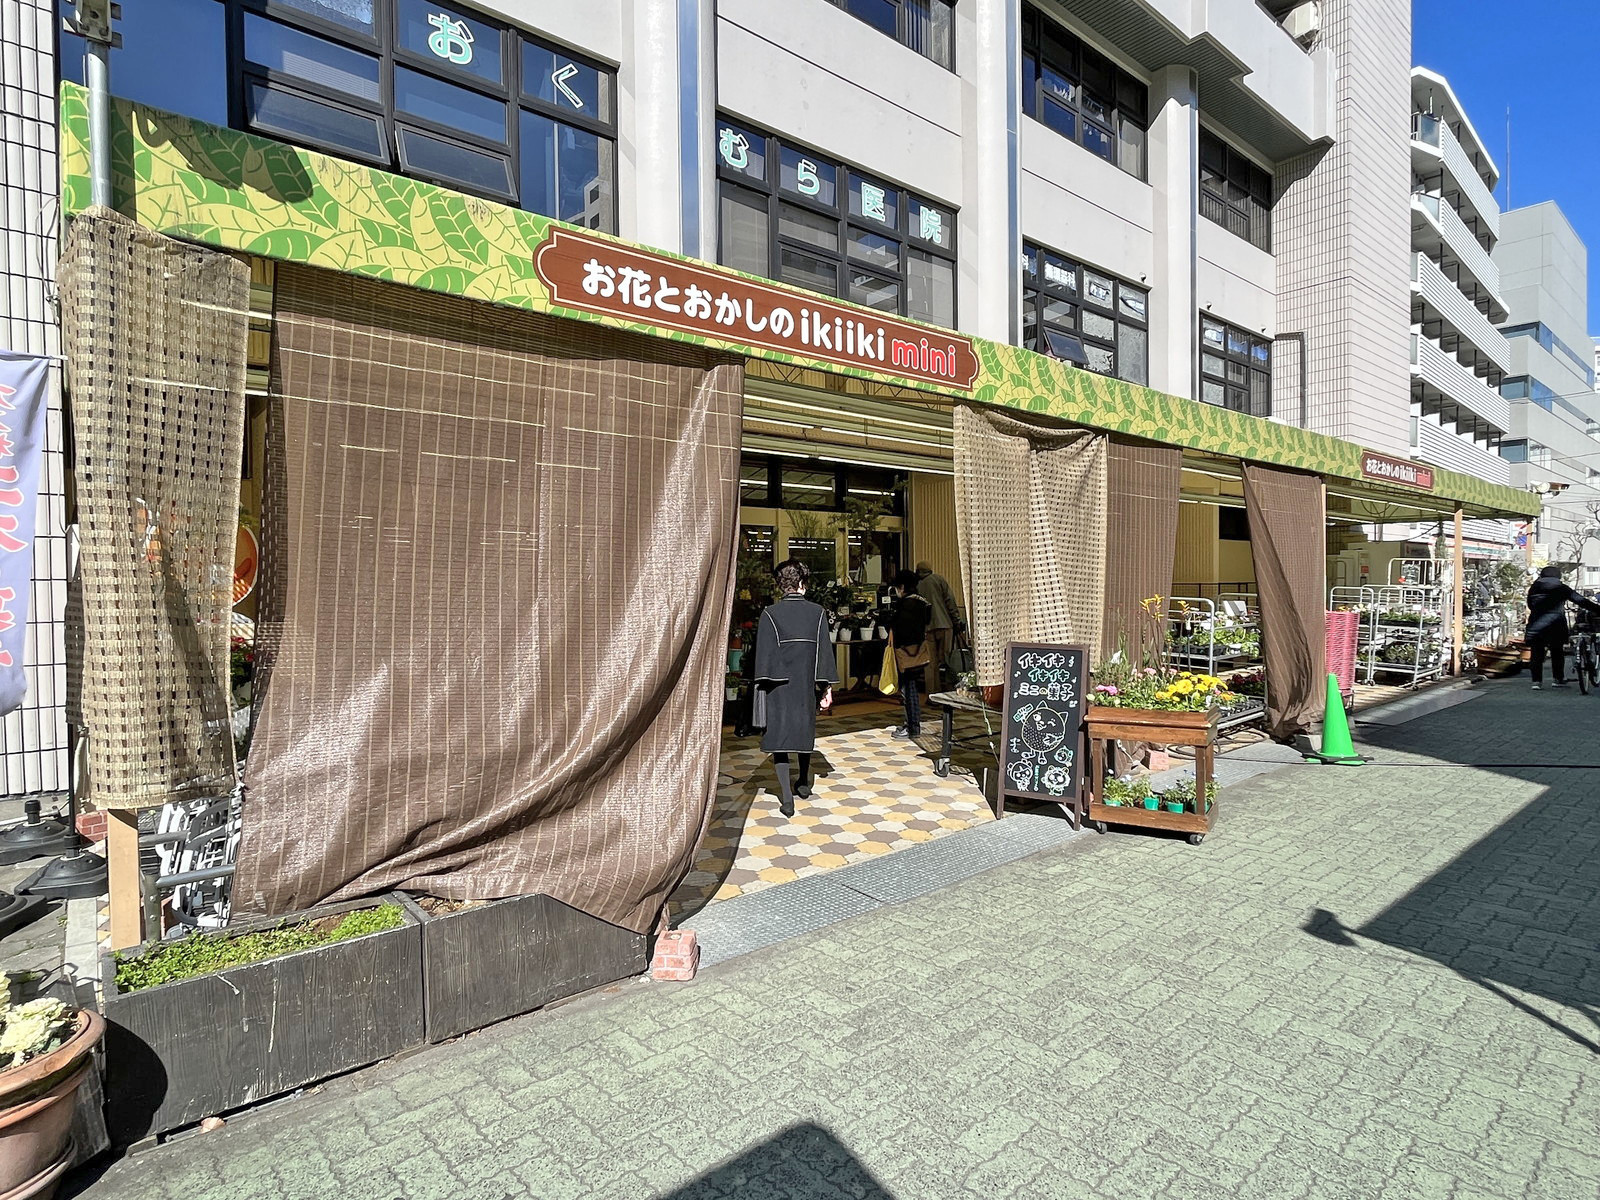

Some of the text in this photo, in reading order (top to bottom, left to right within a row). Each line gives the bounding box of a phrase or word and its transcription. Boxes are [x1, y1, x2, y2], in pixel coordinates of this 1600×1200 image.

[891, 337, 957, 377] mini
[1018, 653, 1065, 669] イキイキ
[1028, 668, 1070, 682] イキイキ
